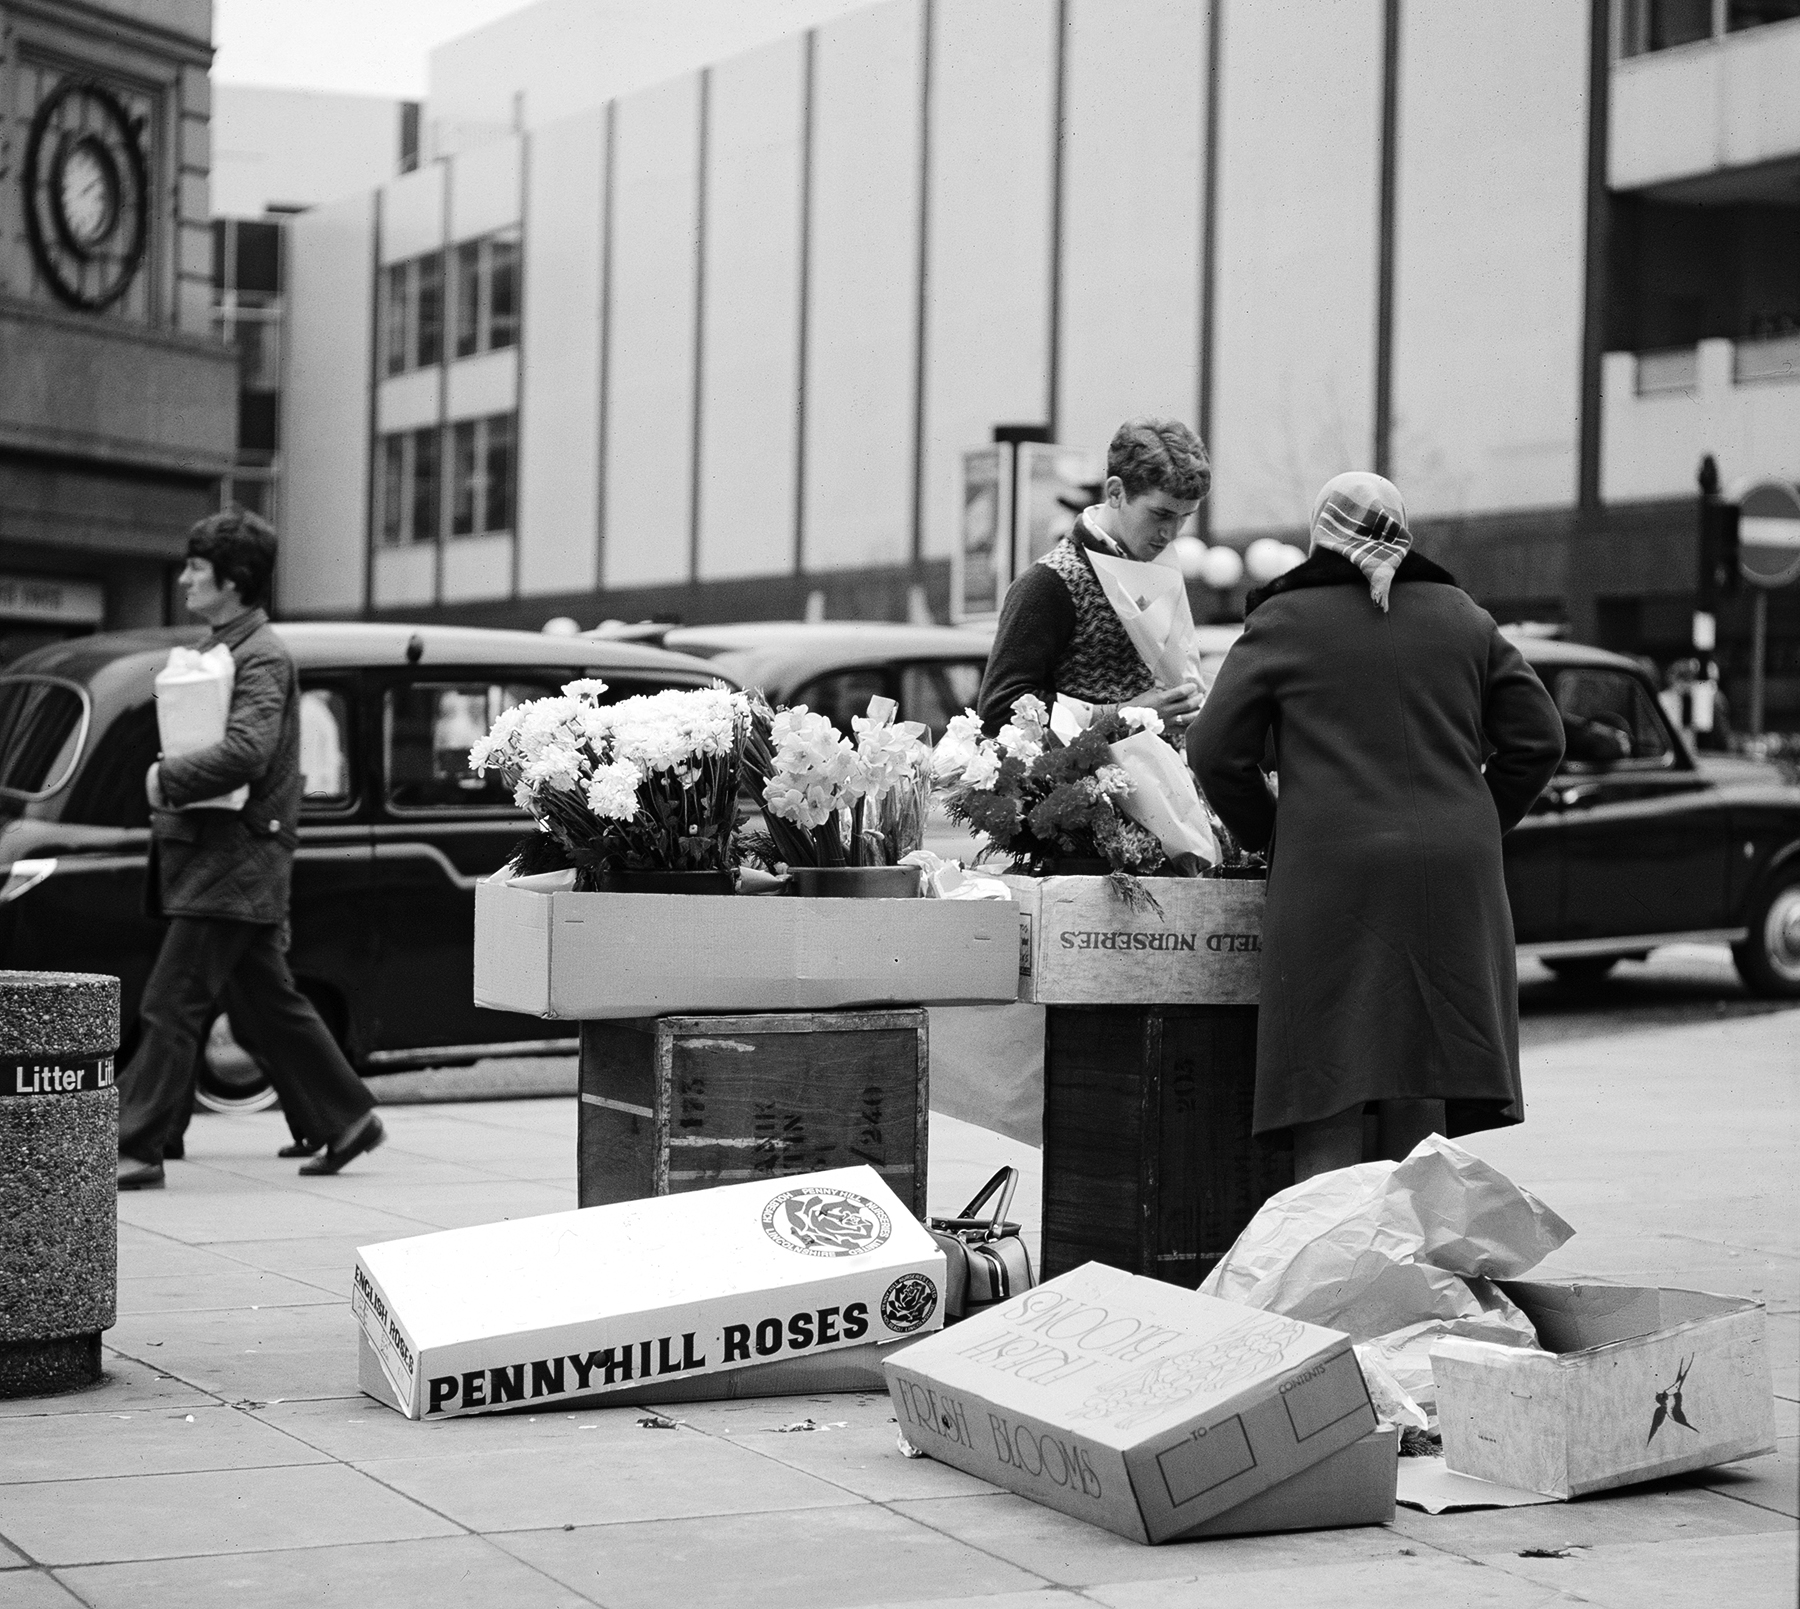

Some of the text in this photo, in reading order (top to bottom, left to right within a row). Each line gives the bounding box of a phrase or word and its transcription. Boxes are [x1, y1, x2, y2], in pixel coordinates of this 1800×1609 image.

[1060, 930, 1262, 953] IELD NURSERIES
[16, 1066, 85, 1093] Litter
[762, 1192, 794, 1223] HOLBEACH
[801, 1187, 891, 1256] PENNY HILL NURSERIES LIMITED
[765, 1228, 837, 1257] LINCOLNSHIRE
[354, 1264, 388, 1326] ENGLISH
[388, 1318, 415, 1375] ROSES
[1000, 1290, 1184, 1363] BLOOMS
[424, 1331, 706, 1415] PENNYHILL
[721, 1302, 870, 1364] ROSES
[956, 1331, 1099, 1387] FRESH
[1279, 1363, 1326, 1395] CONTENTS
[897, 1377, 1102, 1499] FRESH BLOOMS
[1190, 1427, 1209, 1441] TO
